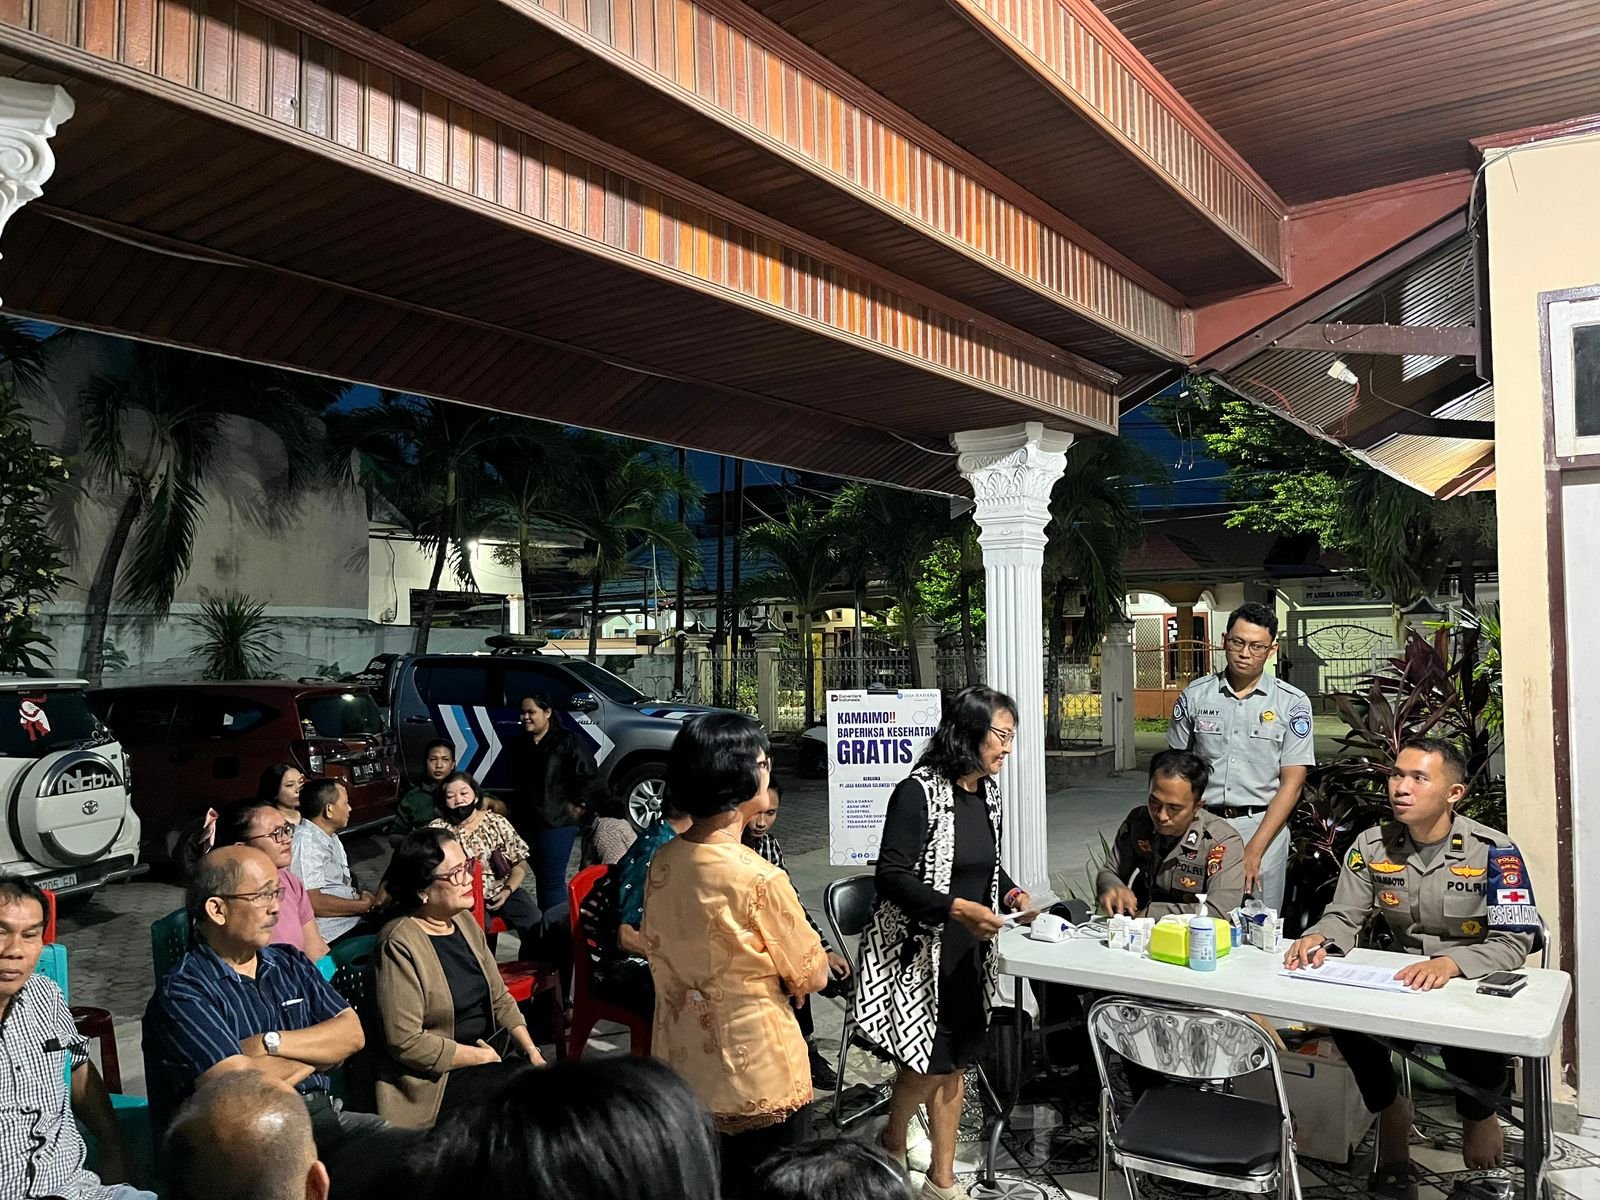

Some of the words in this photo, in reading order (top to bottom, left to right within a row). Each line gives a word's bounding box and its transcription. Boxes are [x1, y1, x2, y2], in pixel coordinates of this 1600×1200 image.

[837, 711, 896, 724] KAMAIMO!!
[837, 727, 884, 738] BAPERIKSA
[887, 726, 937, 737] KESEHATAN
[837, 738, 913, 765] GRATIS
[1175, 862, 1204, 876] POLRI
[1447, 881, 1487, 893] POLRI
